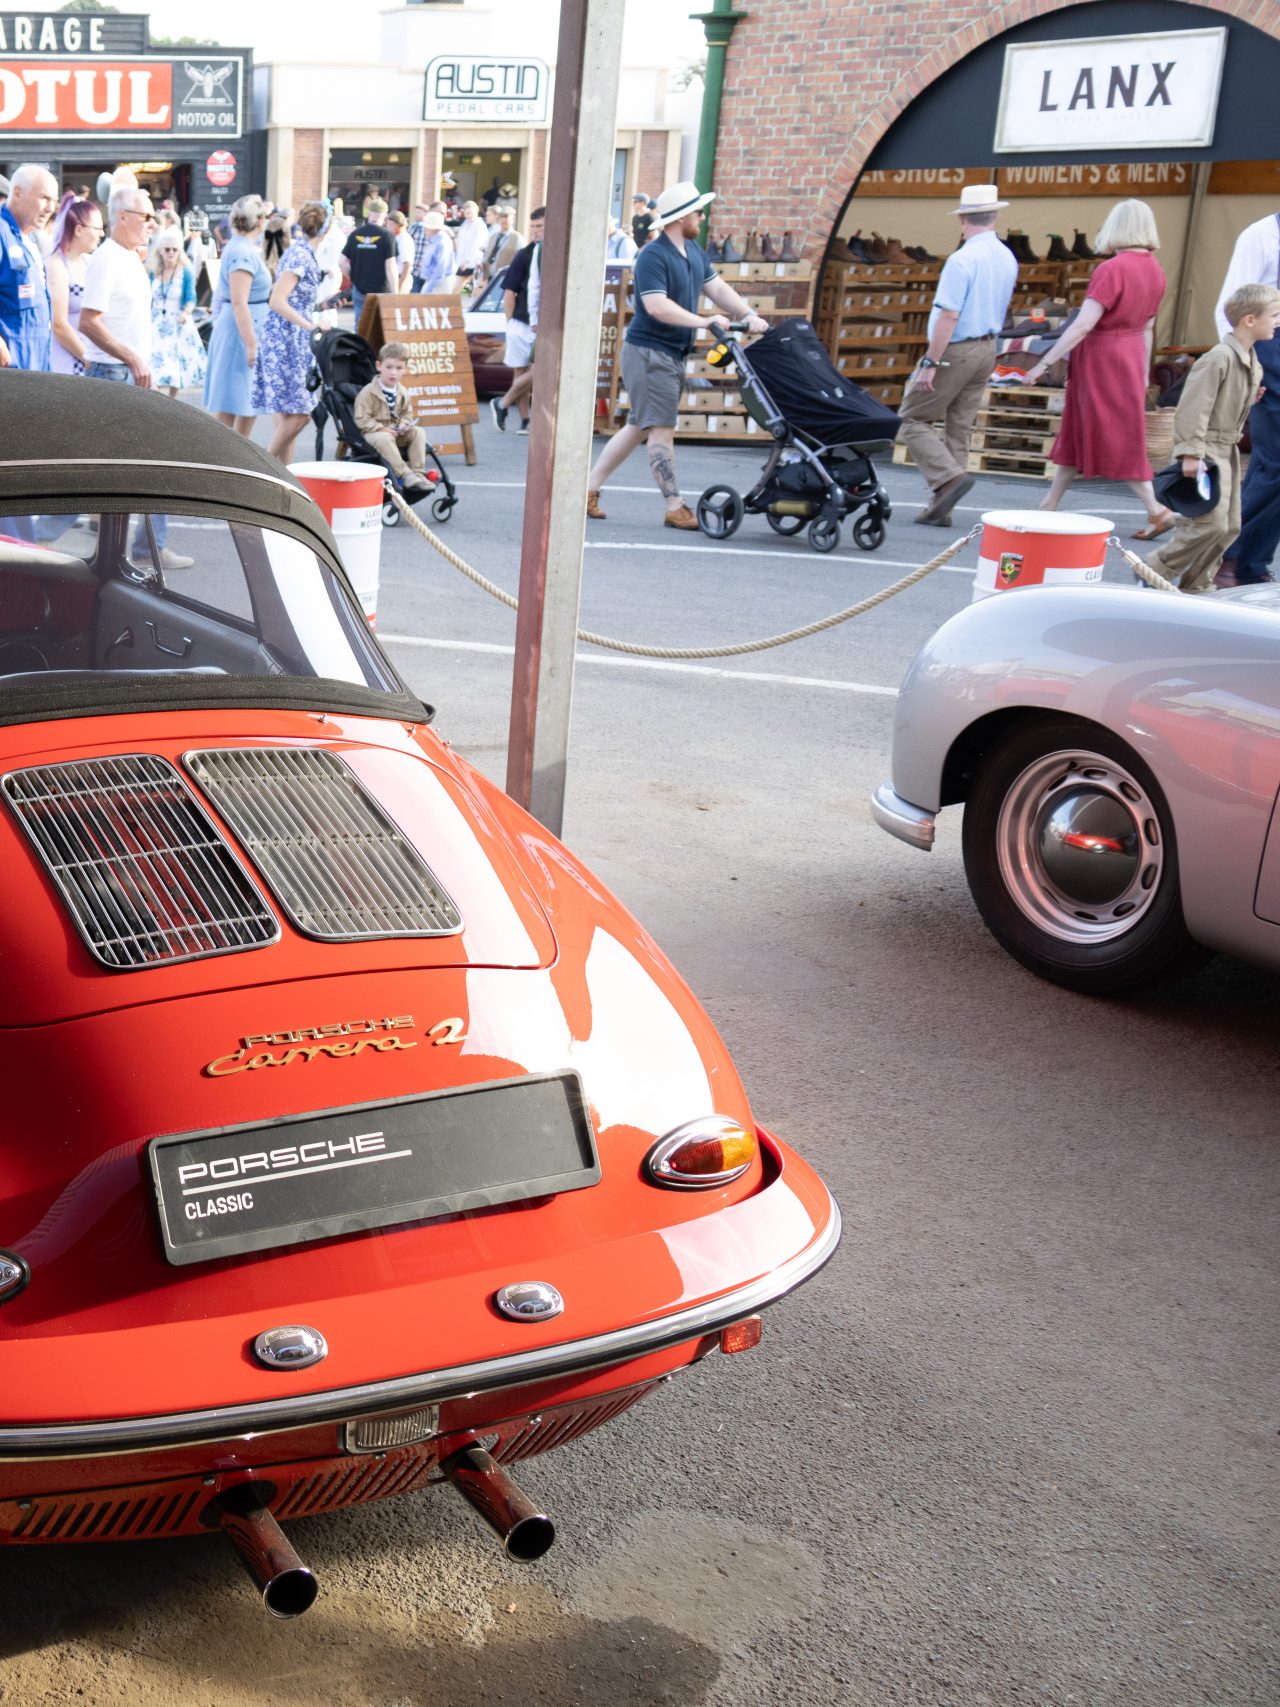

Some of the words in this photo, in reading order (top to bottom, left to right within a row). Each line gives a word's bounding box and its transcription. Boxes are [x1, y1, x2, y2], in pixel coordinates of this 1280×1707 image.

[435, 64, 539, 98] AUSTIN
[1038, 61, 1177, 112] LANX
[177, 113, 216, 127] MOTOR
[219, 113, 236, 127] OIL
[437, 102, 486, 114] PEDAL
[495, 103, 535, 114] CARS
[353, 169, 388, 179] AUSTIN
[1006, 165, 1100, 184] WOMEN'S
[1106, 163, 1121, 183] &
[1127, 162, 1186, 183] MEN'S
[395, 307, 452, 331] LANX
[407, 358, 455, 375] SHOES
[245, 1015, 415, 1048] PORSCHE
[207, 1035, 418, 1076] Carrera
[427, 1017, 469, 1046] 2
[178, 1131, 386, 1184] PORSCHE
[184, 1192, 254, 1220] CLASSIC
